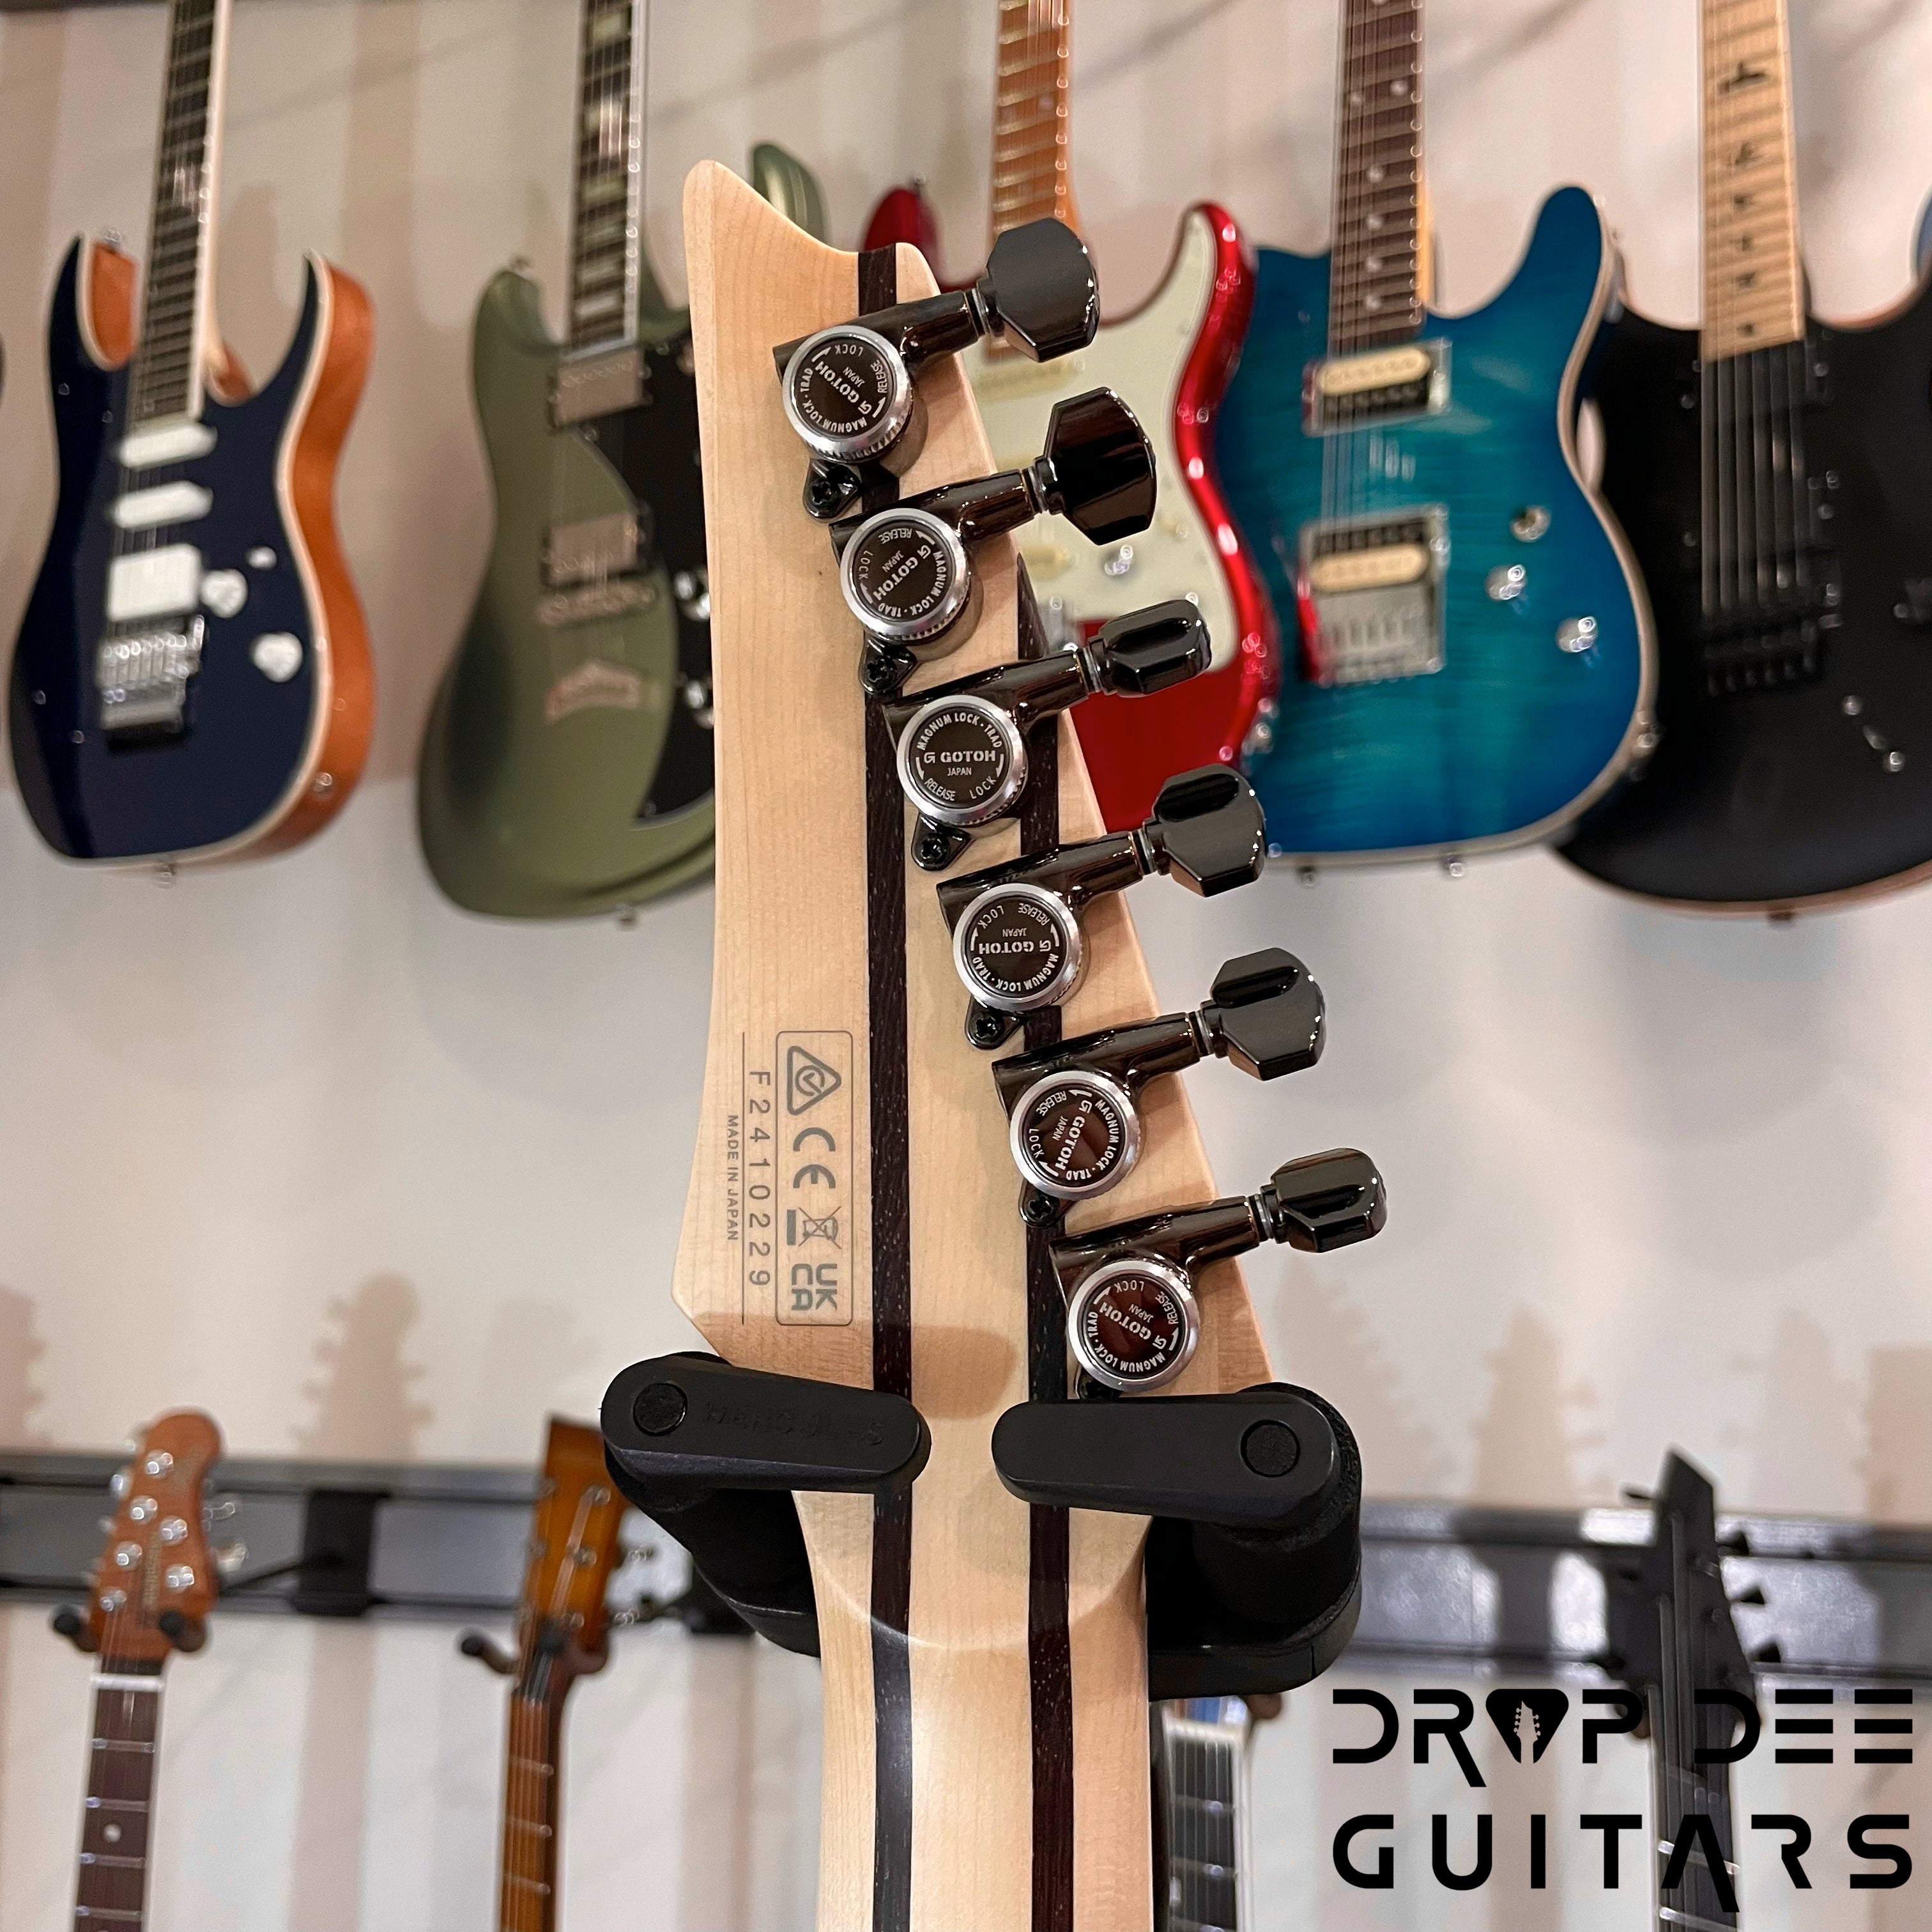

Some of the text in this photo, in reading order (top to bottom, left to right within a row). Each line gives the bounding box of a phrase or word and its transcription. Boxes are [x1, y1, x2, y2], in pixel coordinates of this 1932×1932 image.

[835, 344, 863, 356] LOCK
[815, 362, 859, 402] GOTOH
[843, 367, 864, 387] JAPAN
[871, 360, 887, 393] RELEASE
[801, 368, 867, 433] MAGNUM LOCK TRAD
[878, 528, 912, 544] RELEASE
[859, 550, 873, 579] LOCK
[882, 550, 904, 572] JAPAN
[873, 557, 918, 601] GOTOH
[878, 551, 947, 617] MAGNUM LOCK TRAD
[917, 712, 1002, 750] MAGNUM LOCK TRAD
[940, 751, 995, 763] GOTOH
[947, 767, 971, 776] JAPAN
[924, 778, 956, 801] RELEASE
[969, 776, 996, 799] LOCK
[977, 905, 1004, 929] LOCK
[1018, 903, 1050, 926] RELEASE
[1002, 928, 1027, 937] JAPAN
[979, 941, 1034, 954] GOTOH
[973, 953, 1059, 992] MAGNUM LOCK TRAD
[1036, 1091, 1066, 1116] RELEASE
[1052, 1116, 1068, 1140] JAPAN
[1066, 1100, 1119, 1180] MAGNUM LOCK TRAD
[1029, 1128, 1045, 1158] LOCK
[1055, 1116, 1085, 1170] GOTOH
[727, 1115, 739, 1241] MADE IN JAPAN
[749, 1071, 770, 1286] F2410229
[792, 1263, 813, 1311] CA
[816, 1263, 838, 1311] UK
[1114, 1280, 1144, 1292] LOCK
[1100, 1302, 1151, 1340] GOTOH
[1129, 1304, 1154, 1322] JAPAN
[1155, 1291, 1179, 1324] RELEASE
[1087, 1312, 1166, 1372] MAGNUM LOCK TRAD
